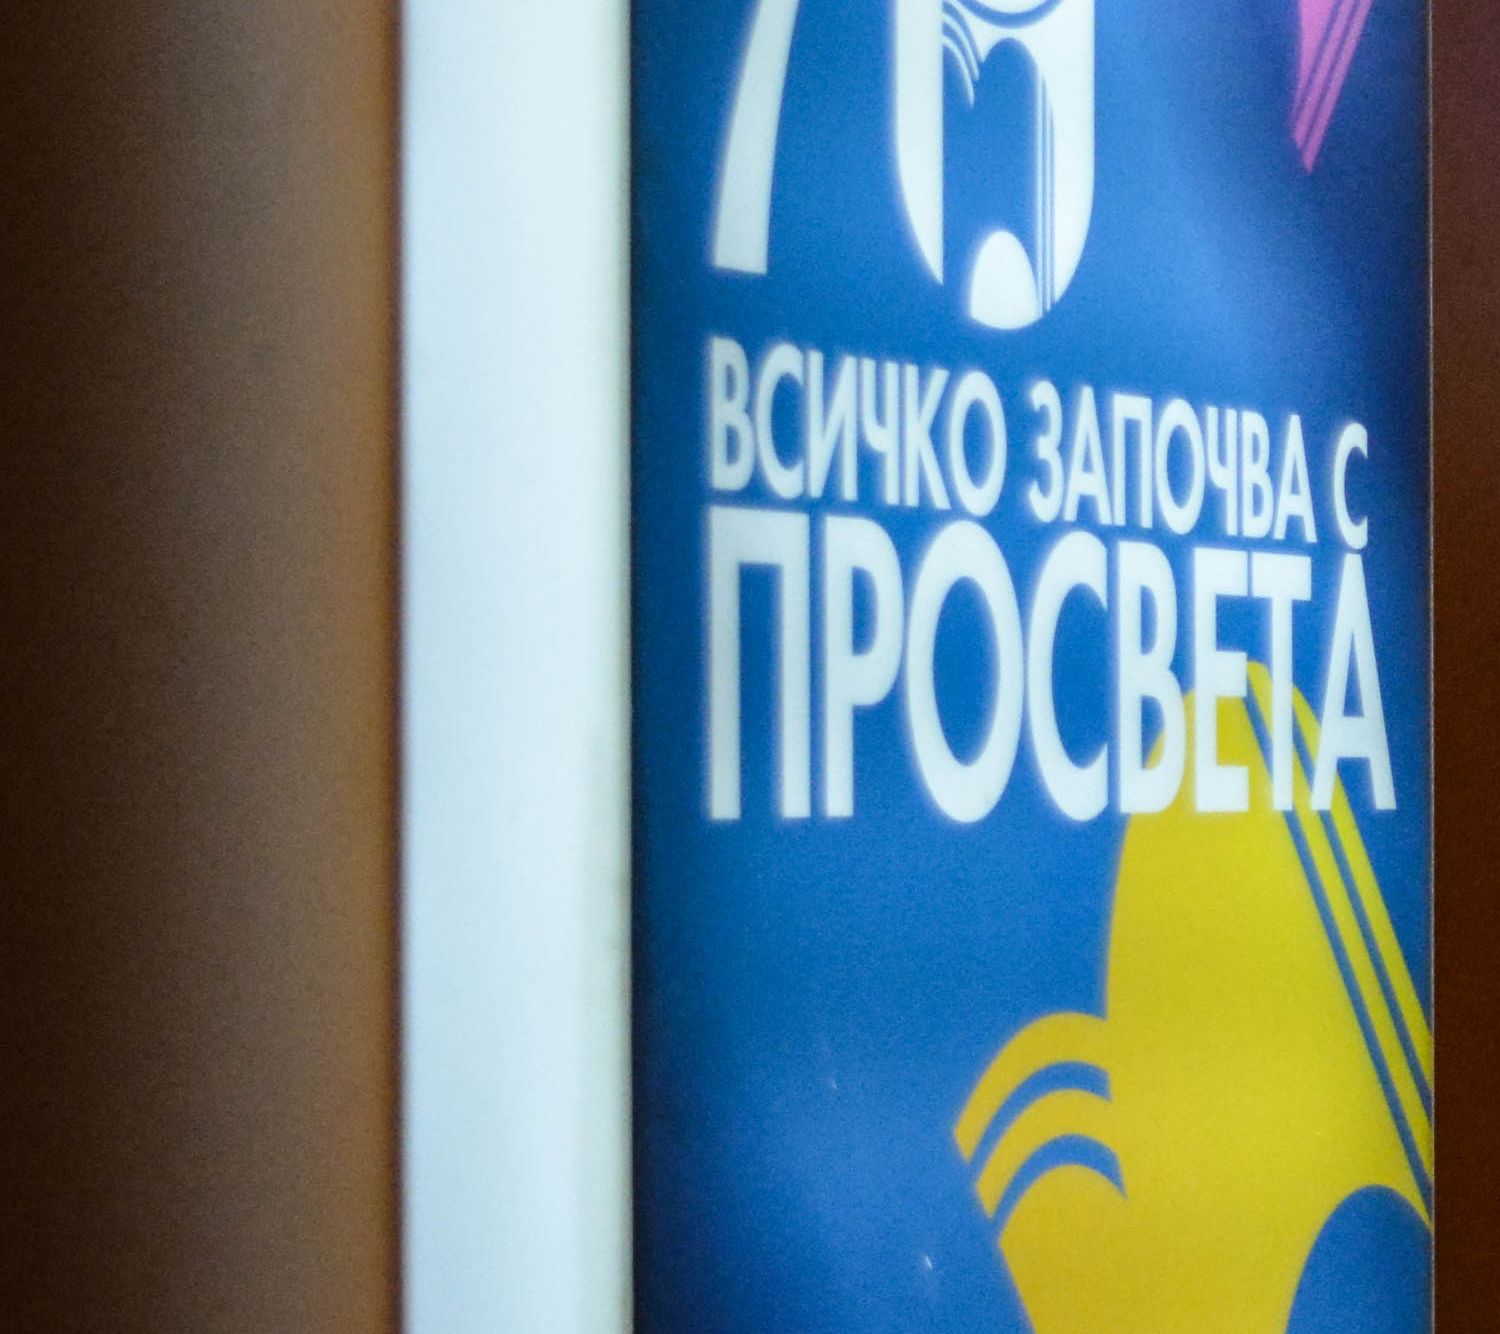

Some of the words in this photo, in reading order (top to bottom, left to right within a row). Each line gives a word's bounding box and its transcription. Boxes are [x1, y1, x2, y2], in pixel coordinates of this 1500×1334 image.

[709, 336, 1007, 517] ВСИЧКО
[1029, 381, 1318, 543] ЗАПОЧВА
[708, 505, 1398, 824] ПРОСВЕТА
